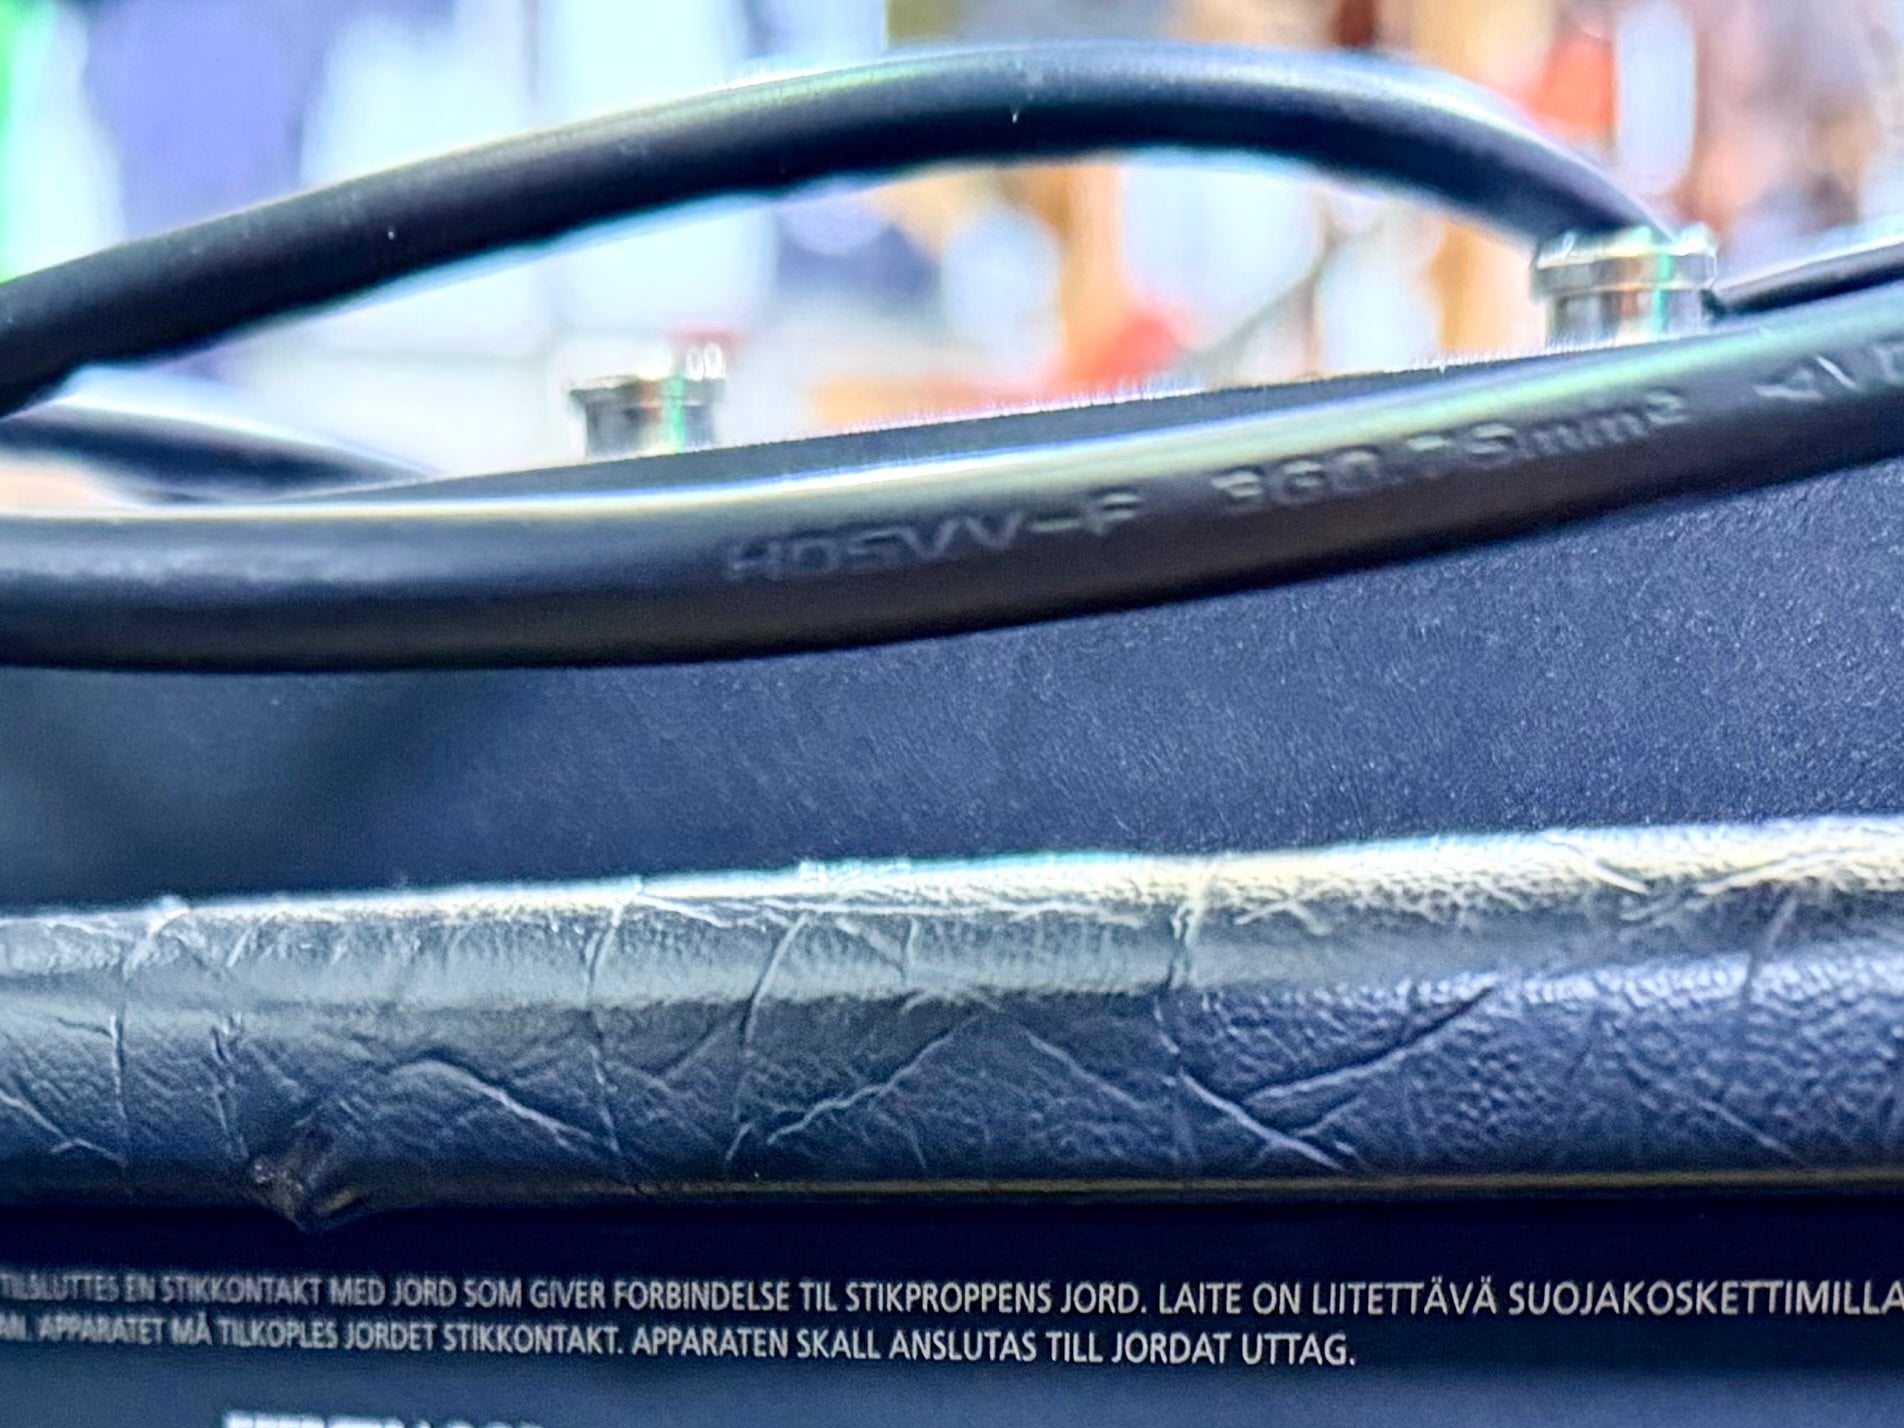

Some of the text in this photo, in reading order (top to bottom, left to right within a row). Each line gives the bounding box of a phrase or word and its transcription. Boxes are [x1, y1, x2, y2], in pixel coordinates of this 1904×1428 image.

[125, 1273, 156, 1302] EN
[161, 1274, 322, 1304] STIKKONTAKT
[330, 1276, 386, 1305] MED
[393, 1277, 457, 1307] JORD
[464, 1278, 523, 1309] SOM
[529, 1279, 607, 1310] GIVER
[613, 1280, 791, 1312] FORBINDELSE
[798, 1282, 838, 1313] TIL
[845, 1282, 1052, 1314] STIKPROPPENS
[1061, 1283, 1148, 1315] JORD.
[1158, 1282, 1242, 1315] LAITE
[1252, 1282, 1300, 1315] ON
[1312, 1276, 1497, 1316] LIITETTÄVÄ
[38, 1312, 163, 1344] APPARATET
[171, 1311, 213, 1346] MÅ
[218, 1316, 338, 1349] TILKOPLES
[343, 1319, 436, 1351] JORDET
[442, 1322, 624, 1355] STIKKONTAKT.
[631, 1325, 789, 1358] APPARATEN
[796, 1328, 881, 1359] SKALL
[888, 1329, 1037, 1362] ANSLUTAS
[1045, 1330, 1104, 1363] TILL
[1111, 1332, 1233, 1366] JORDAT
[1240, 1333, 1358, 1367] UTTAG.
